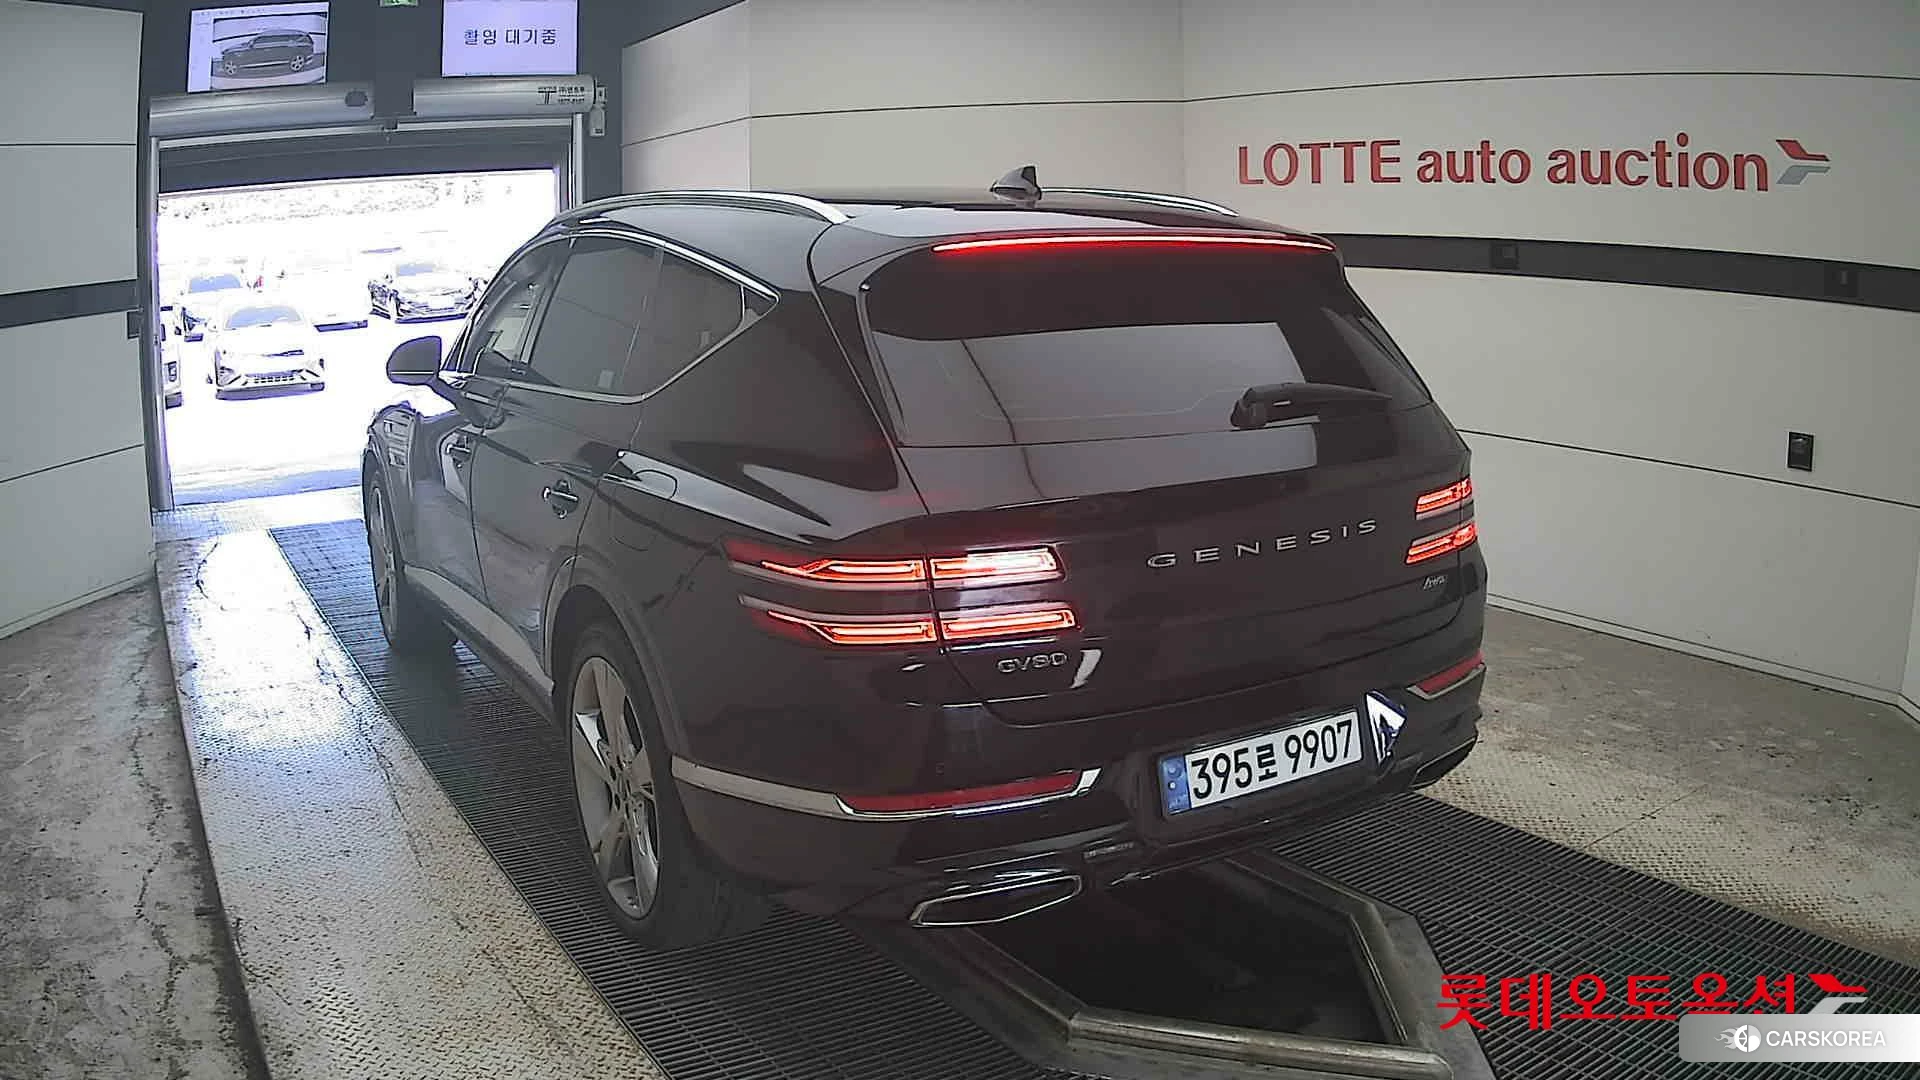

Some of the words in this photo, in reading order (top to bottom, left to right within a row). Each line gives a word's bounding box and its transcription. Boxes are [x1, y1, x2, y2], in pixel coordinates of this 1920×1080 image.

[505, 28, 556, 45] 대기중
[1239, 139, 1401, 185] LOTTE
[1416, 140, 1532, 184] auto
[1547, 133, 1768, 191] auction
[1148, 519, 1376, 567] GENESIS
[998, 652, 1067, 673] GV80
[1191, 743, 1278, 799] 395로
[1284, 719, 1352, 774] 9907
